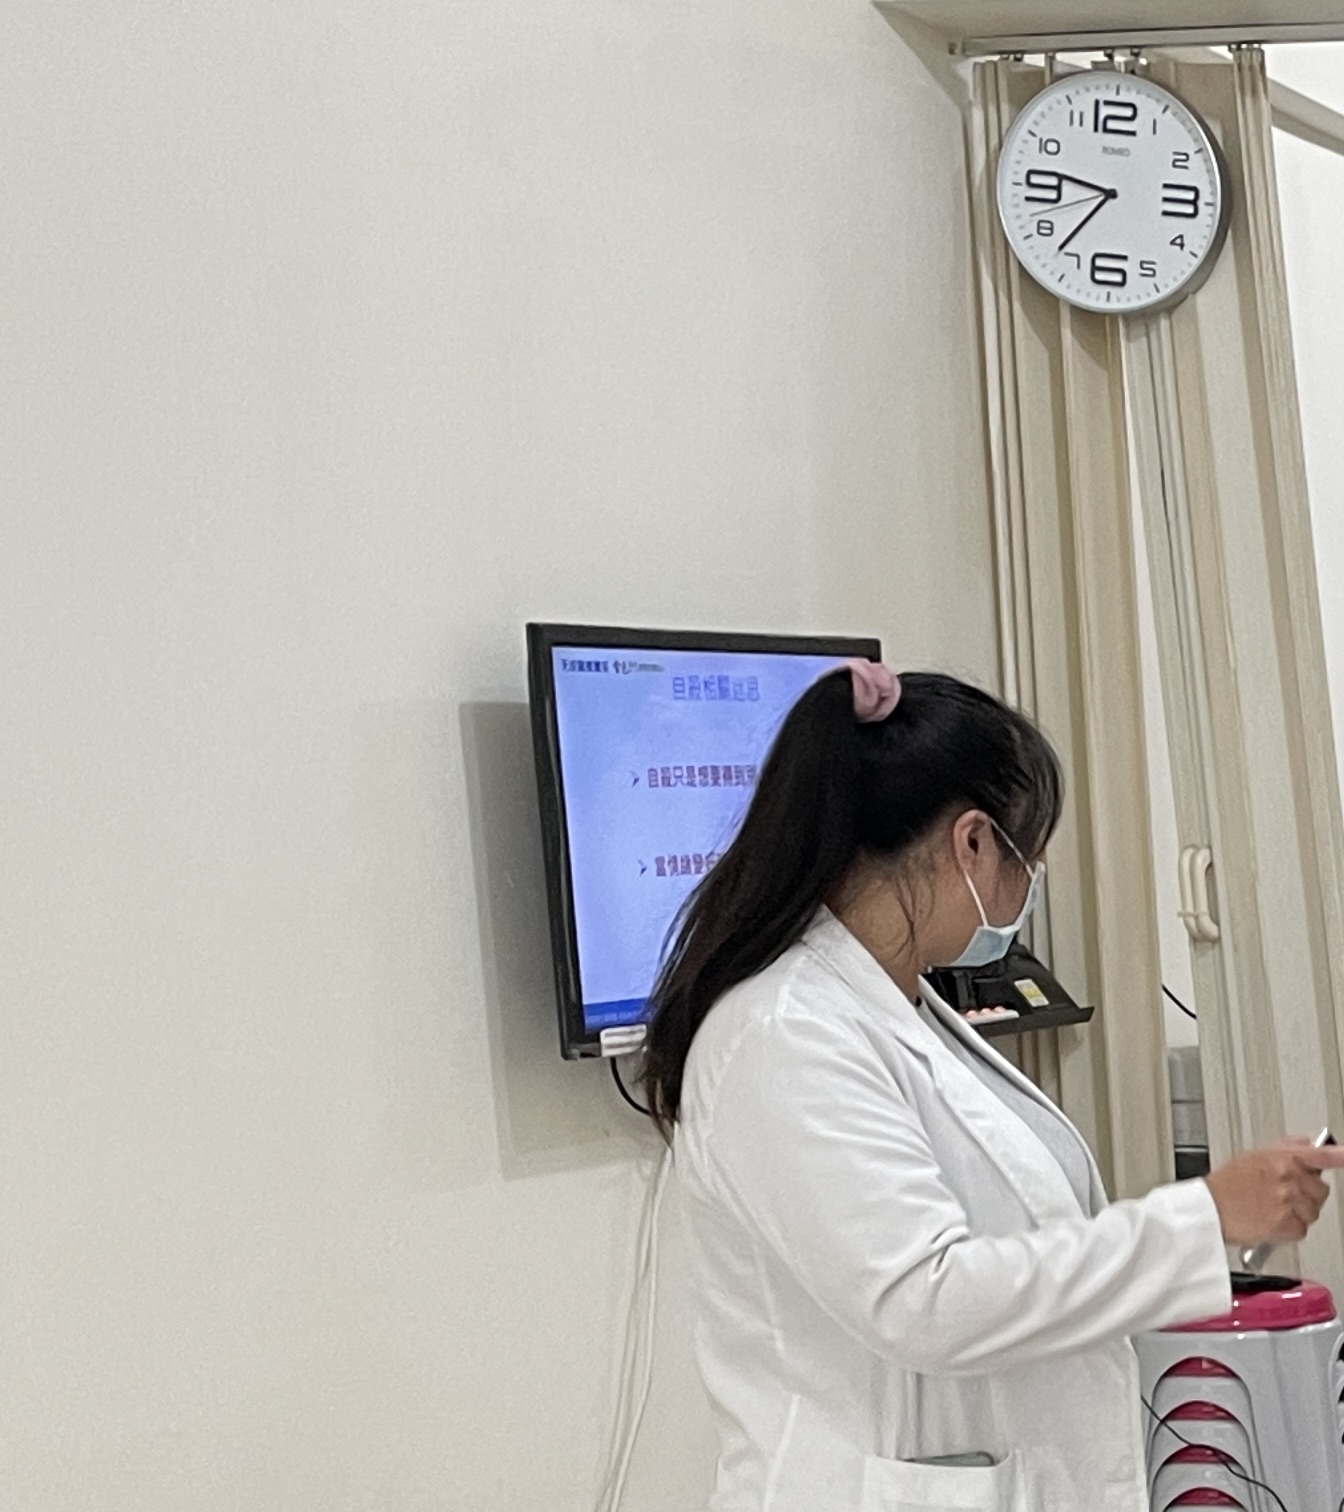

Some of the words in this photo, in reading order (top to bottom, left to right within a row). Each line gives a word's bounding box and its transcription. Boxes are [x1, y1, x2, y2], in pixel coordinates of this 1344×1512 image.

[1069, 109, 1084, 128] 11
[1093, 99, 1138, 137] 12
[1038, 137, 1062, 156] 10
[1172, 151, 1190, 170] 2
[1024, 169, 1064, 204] 9
[1161, 183, 1200, 219] 3
[1036, 219, 1054, 237] 8
[1169, 234, 1186, 251] 4
[1063, 251, 1081, 270] 7
[1090, 252, 1129, 287] 6
[1139, 260, 1156, 278] 5
